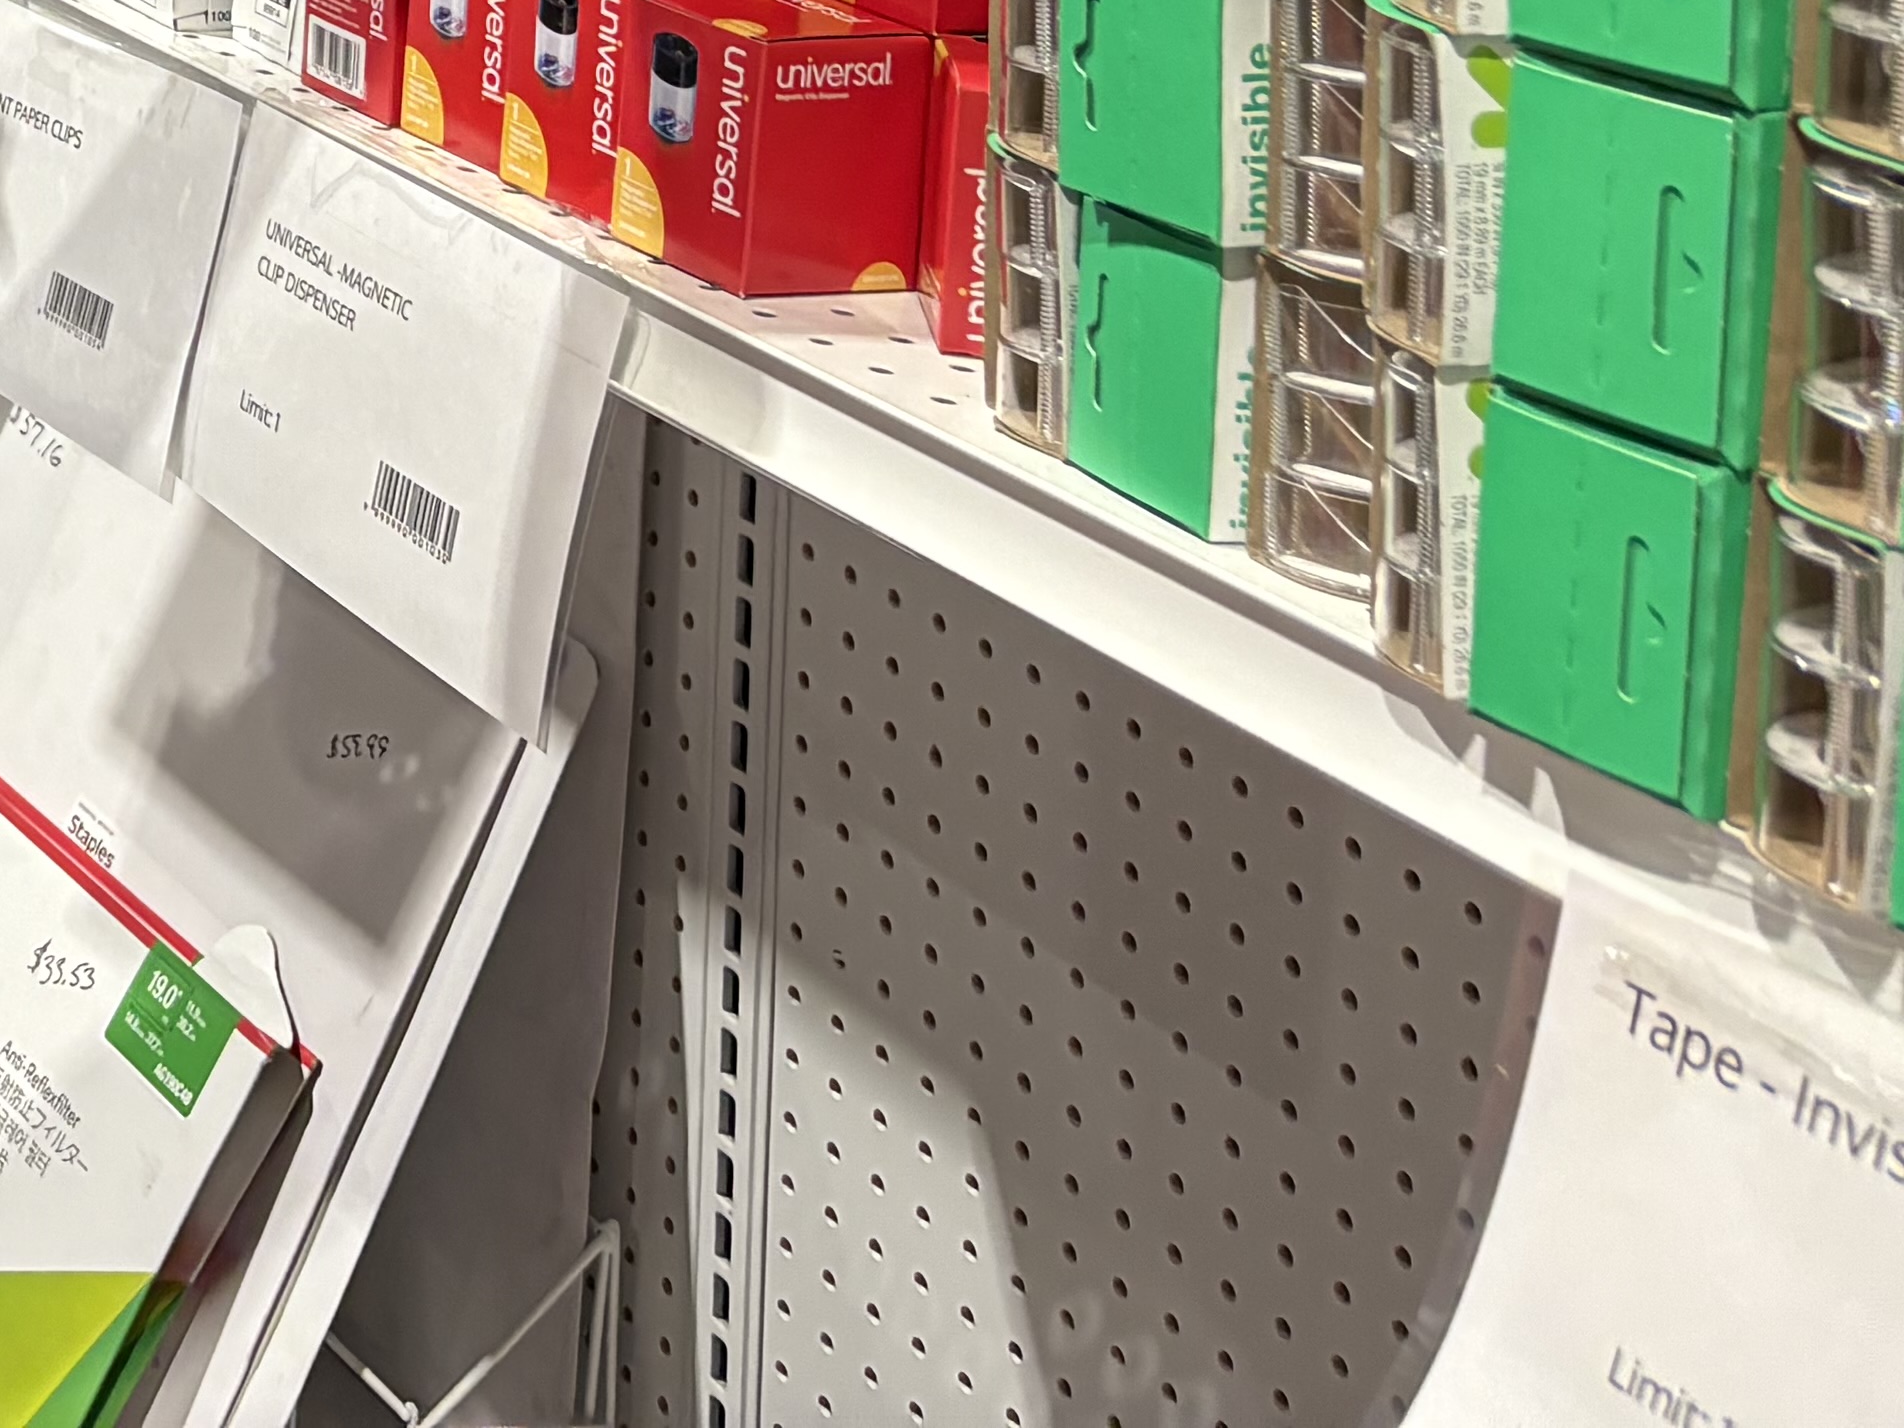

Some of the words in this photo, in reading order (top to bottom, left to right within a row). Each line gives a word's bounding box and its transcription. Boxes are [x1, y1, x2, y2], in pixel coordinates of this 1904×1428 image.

[776, 51, 892, 89] universal
[13, 102, 49, 133] PAPER
[50, 118, 83, 149] CLIPS
[710, 45, 748, 219] universal
[1240, 42, 1271, 234] invisible
[258, 256, 287, 291] CLIP
[286, 269, 357, 332] DISPENSER
[266, 218, 334, 278] UNIVERSAL
[337, 263, 413, 322] -MAGNETIC
[67, 815, 115, 868] Staples
[27, 938, 96, 989] $33.53
[1625, 981, 1744, 1091] Tape
[0, 1040, 81, 1129] Anti-Reflexfilter
